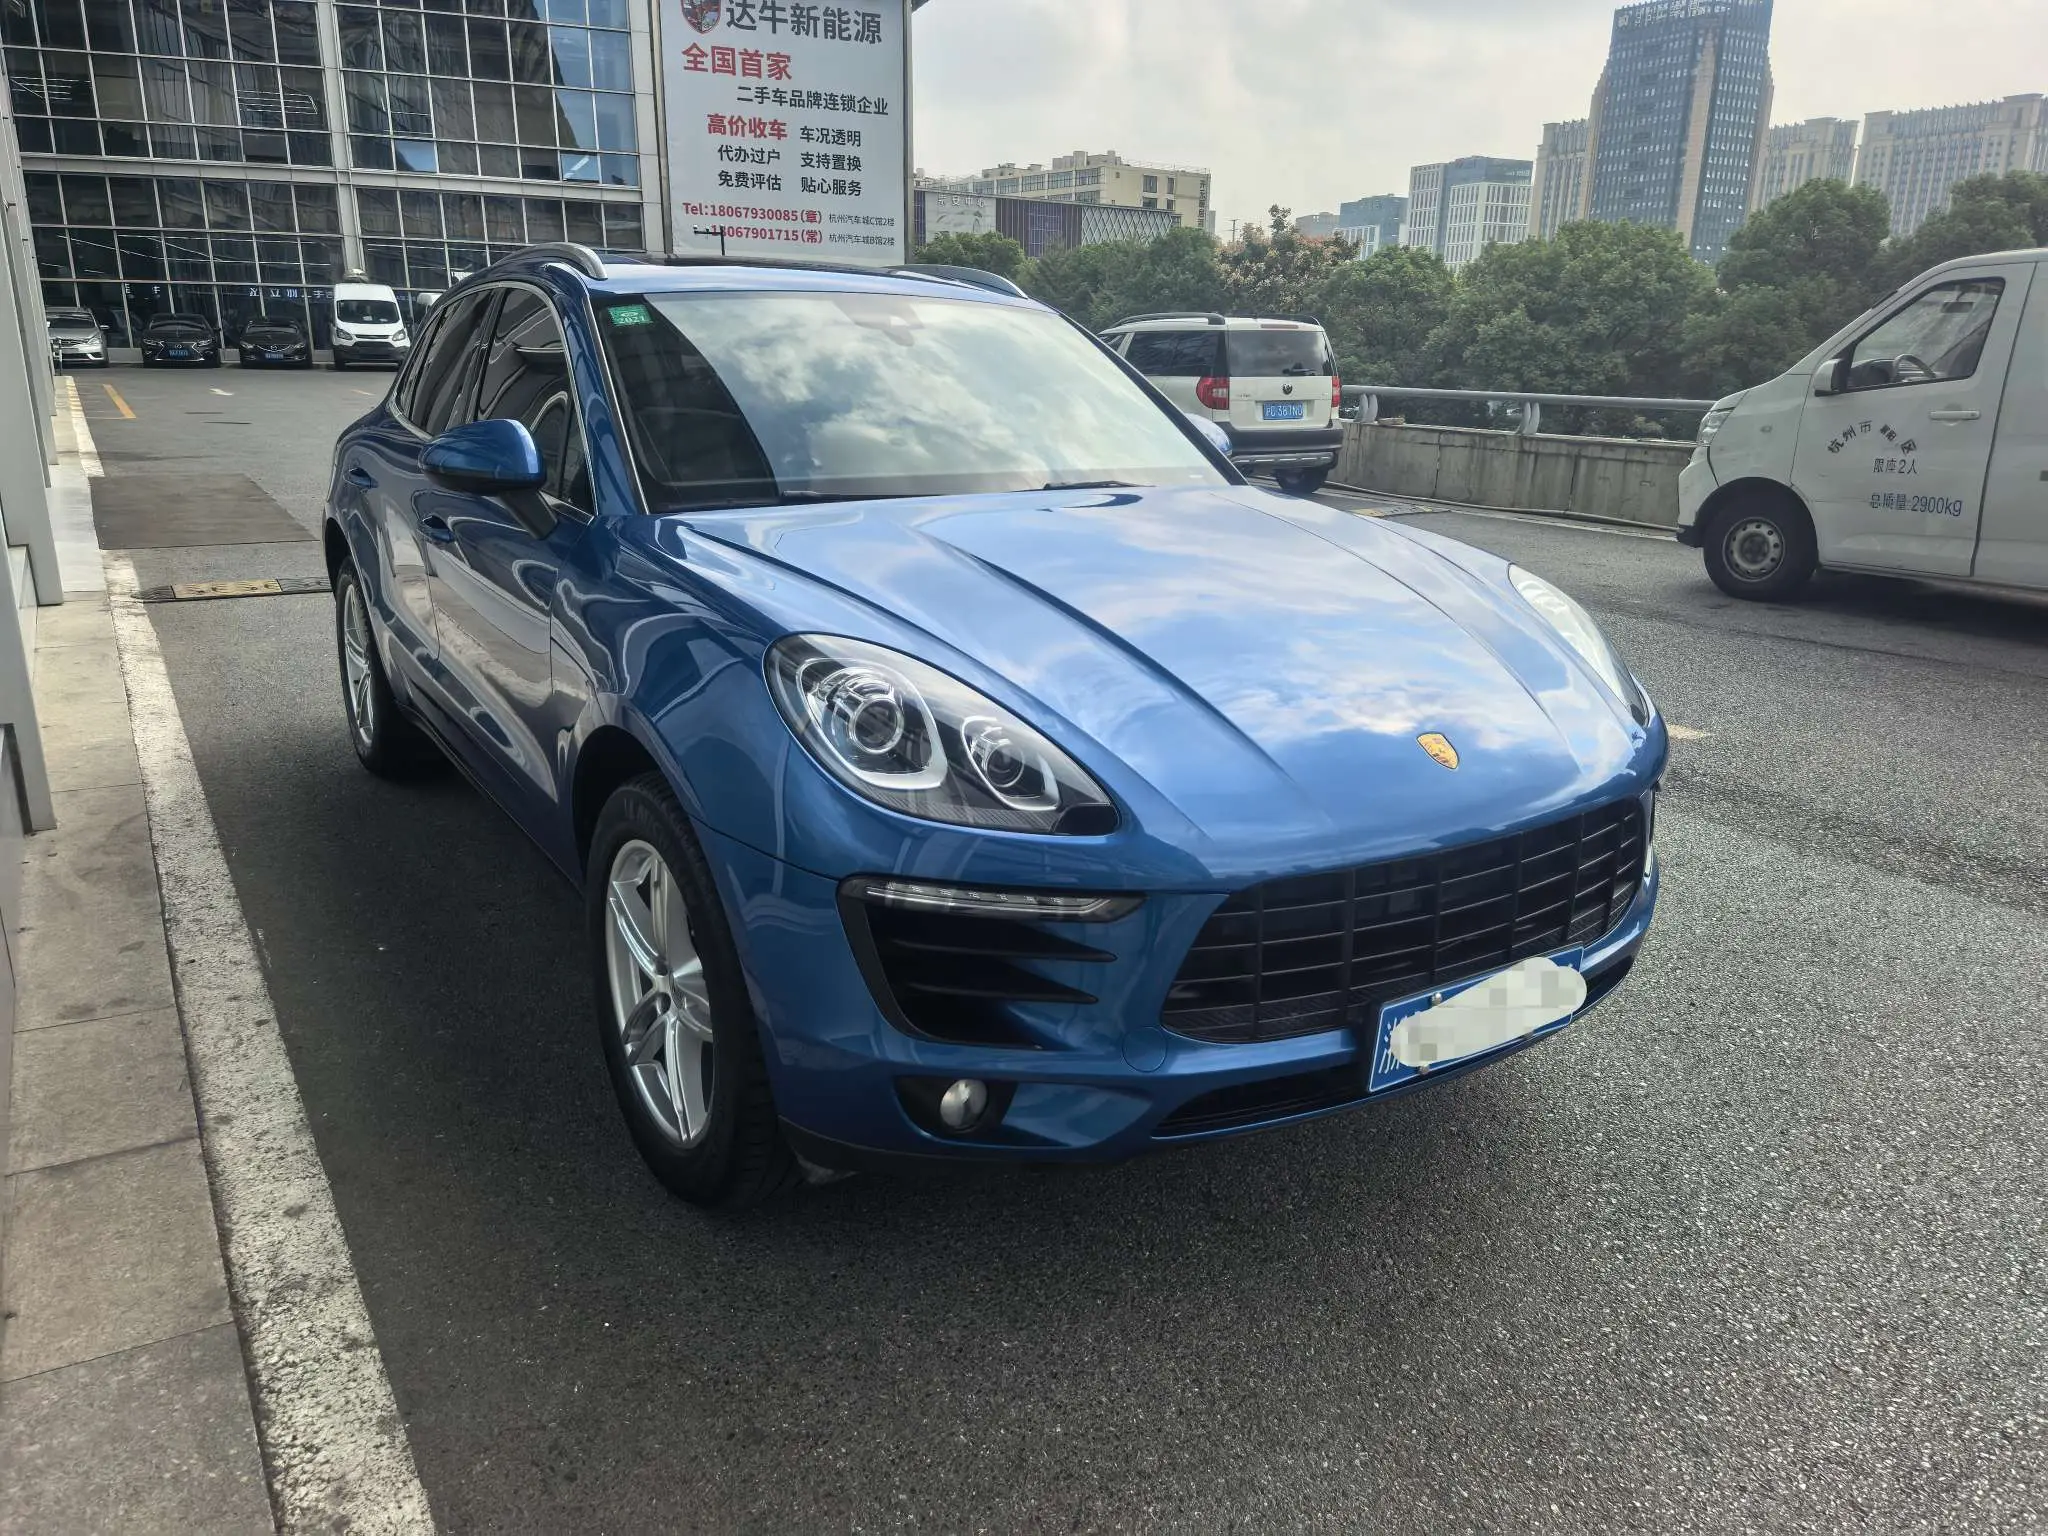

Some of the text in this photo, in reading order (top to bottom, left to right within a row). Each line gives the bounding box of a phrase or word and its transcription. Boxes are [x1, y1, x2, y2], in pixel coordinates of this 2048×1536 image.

[725, 0, 883, 45] 达牛新能源
[681, 42, 793, 81] 全国首家
[736, 85, 889, 116] 二手车品牌连锁企业
[706, 113, 788, 141] 高价收车
[799, 125, 862, 148] 车况透明
[717, 144, 781, 165] 代办过户
[799, 152, 862, 172] 支持置换
[717, 169, 782, 192] 免费评估
[800, 176, 862, 197] 贴心服务
[1873, 458, 1918, 474] 限座2人
